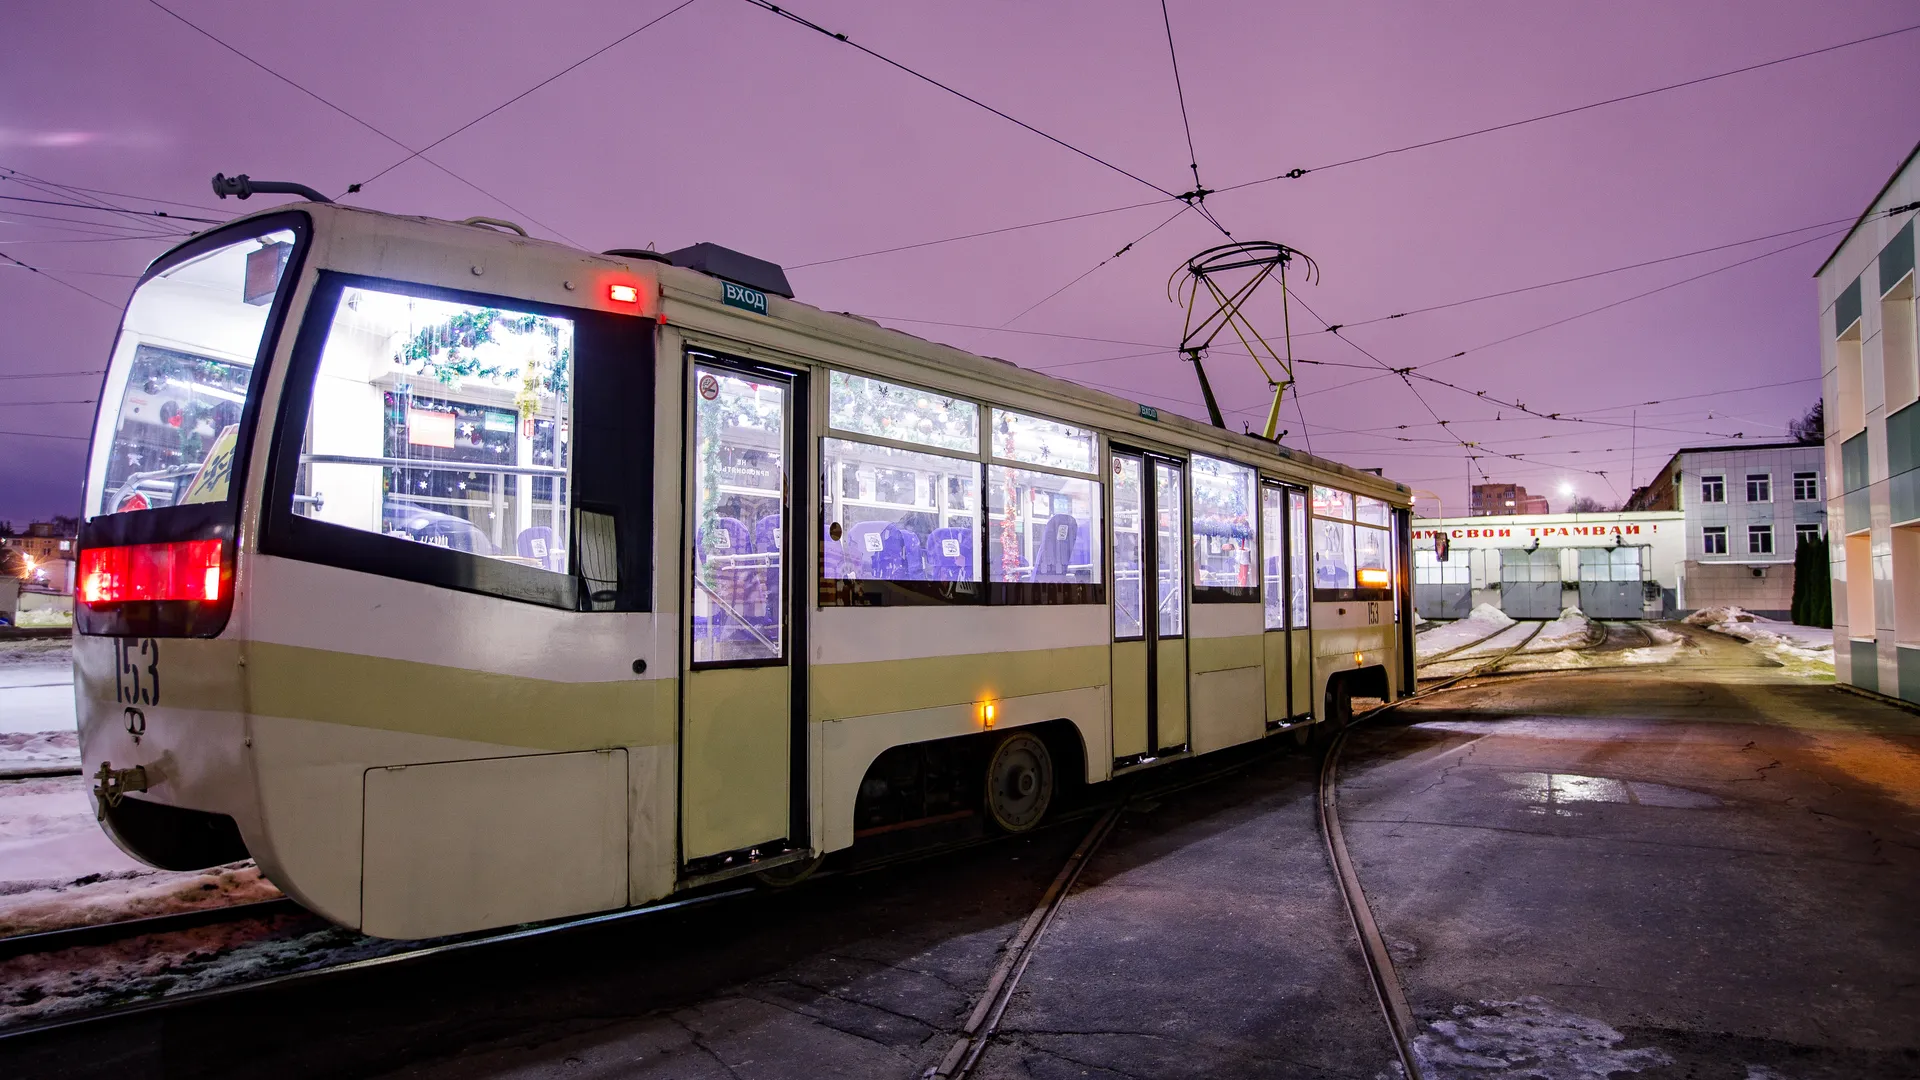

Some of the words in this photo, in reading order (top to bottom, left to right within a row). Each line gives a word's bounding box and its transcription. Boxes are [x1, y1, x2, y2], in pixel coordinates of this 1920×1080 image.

[726, 284, 764, 310] ВХОД
[1526, 523, 1640, 537] ТРАМВАЙ
[1368, 602, 1379, 625] 153
[114, 637, 160, 706] 153
